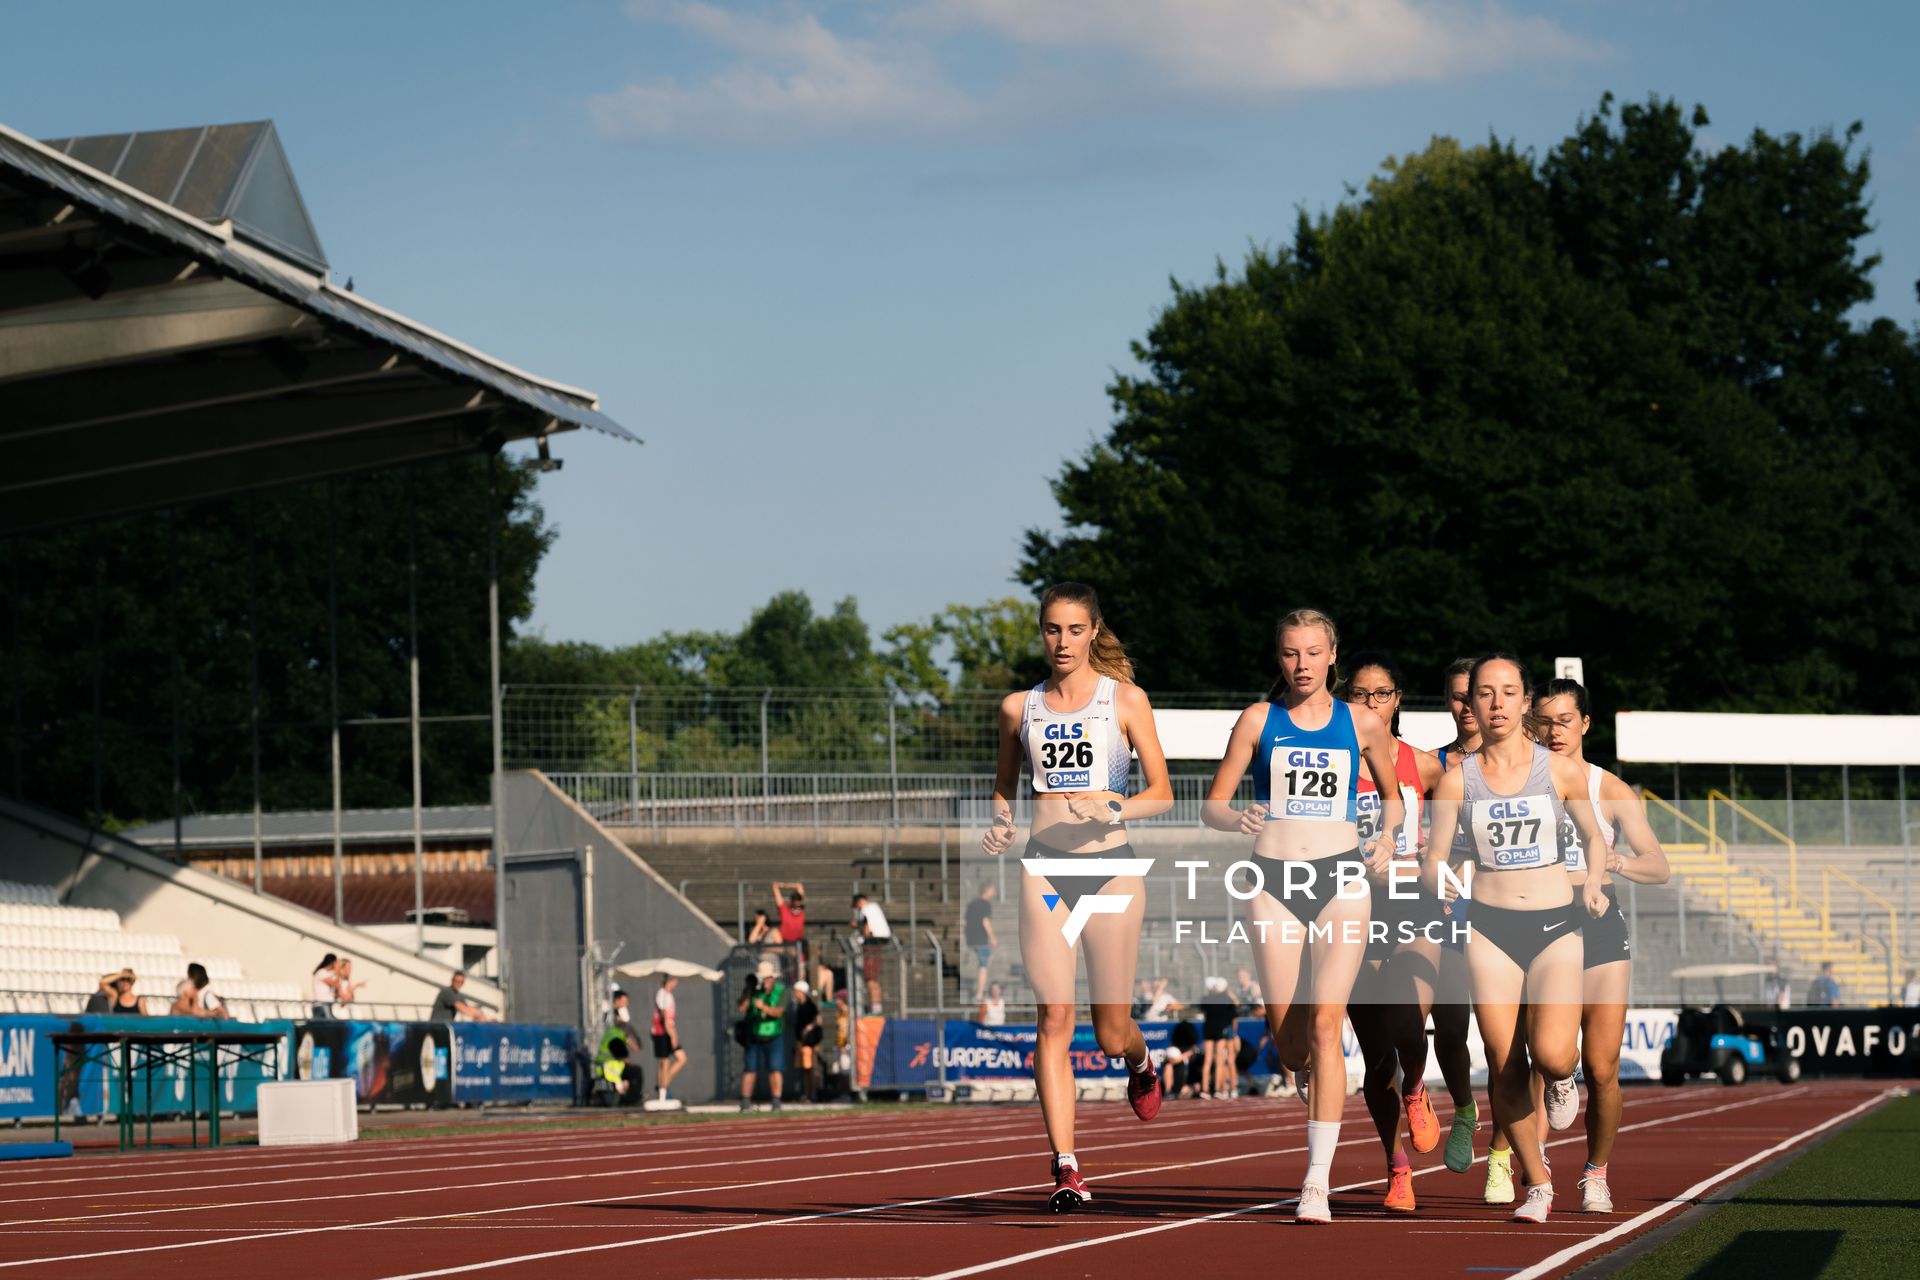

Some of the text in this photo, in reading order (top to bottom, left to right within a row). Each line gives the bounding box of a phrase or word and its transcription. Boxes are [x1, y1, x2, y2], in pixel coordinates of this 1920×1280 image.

[1041, 742, 1093, 769] 326
[1063, 773, 1089, 782] PLAN
[1285, 770, 1338, 798] 128
[1305, 803, 1331, 812] PLAN
[1487, 818, 1542, 848] 377
[1513, 849, 1538, 859] PLAN
[932, 1046, 1022, 1069] EUROPEAN
